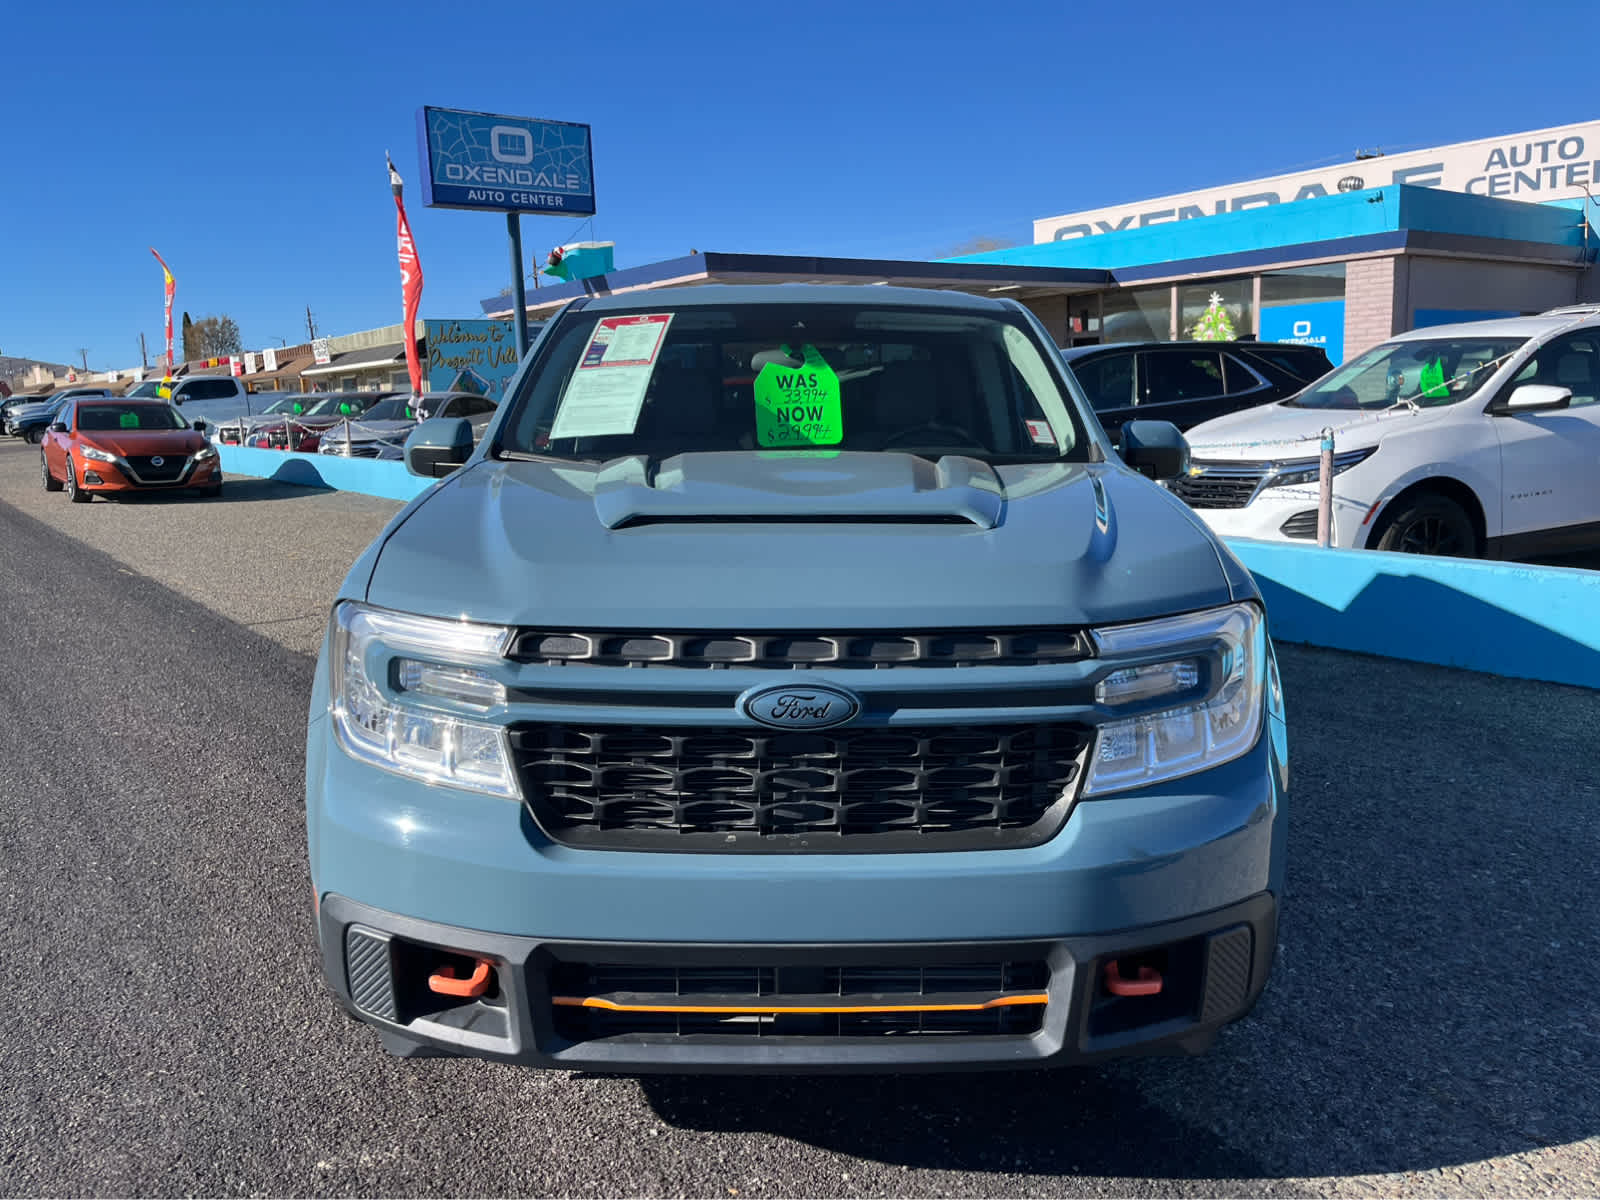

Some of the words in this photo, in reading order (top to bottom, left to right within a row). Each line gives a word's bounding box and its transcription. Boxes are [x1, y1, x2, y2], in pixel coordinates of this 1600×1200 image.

[1484, 136, 1585, 172] AUTO
[446, 163, 580, 189] OXENDALE
[468, 190, 505, 202] AUTO
[511, 193, 564, 206] CENTER
[776, 373, 818, 388] WAS
[776, 405, 824, 423] NOW
[771, 694, 831, 719] Ford
